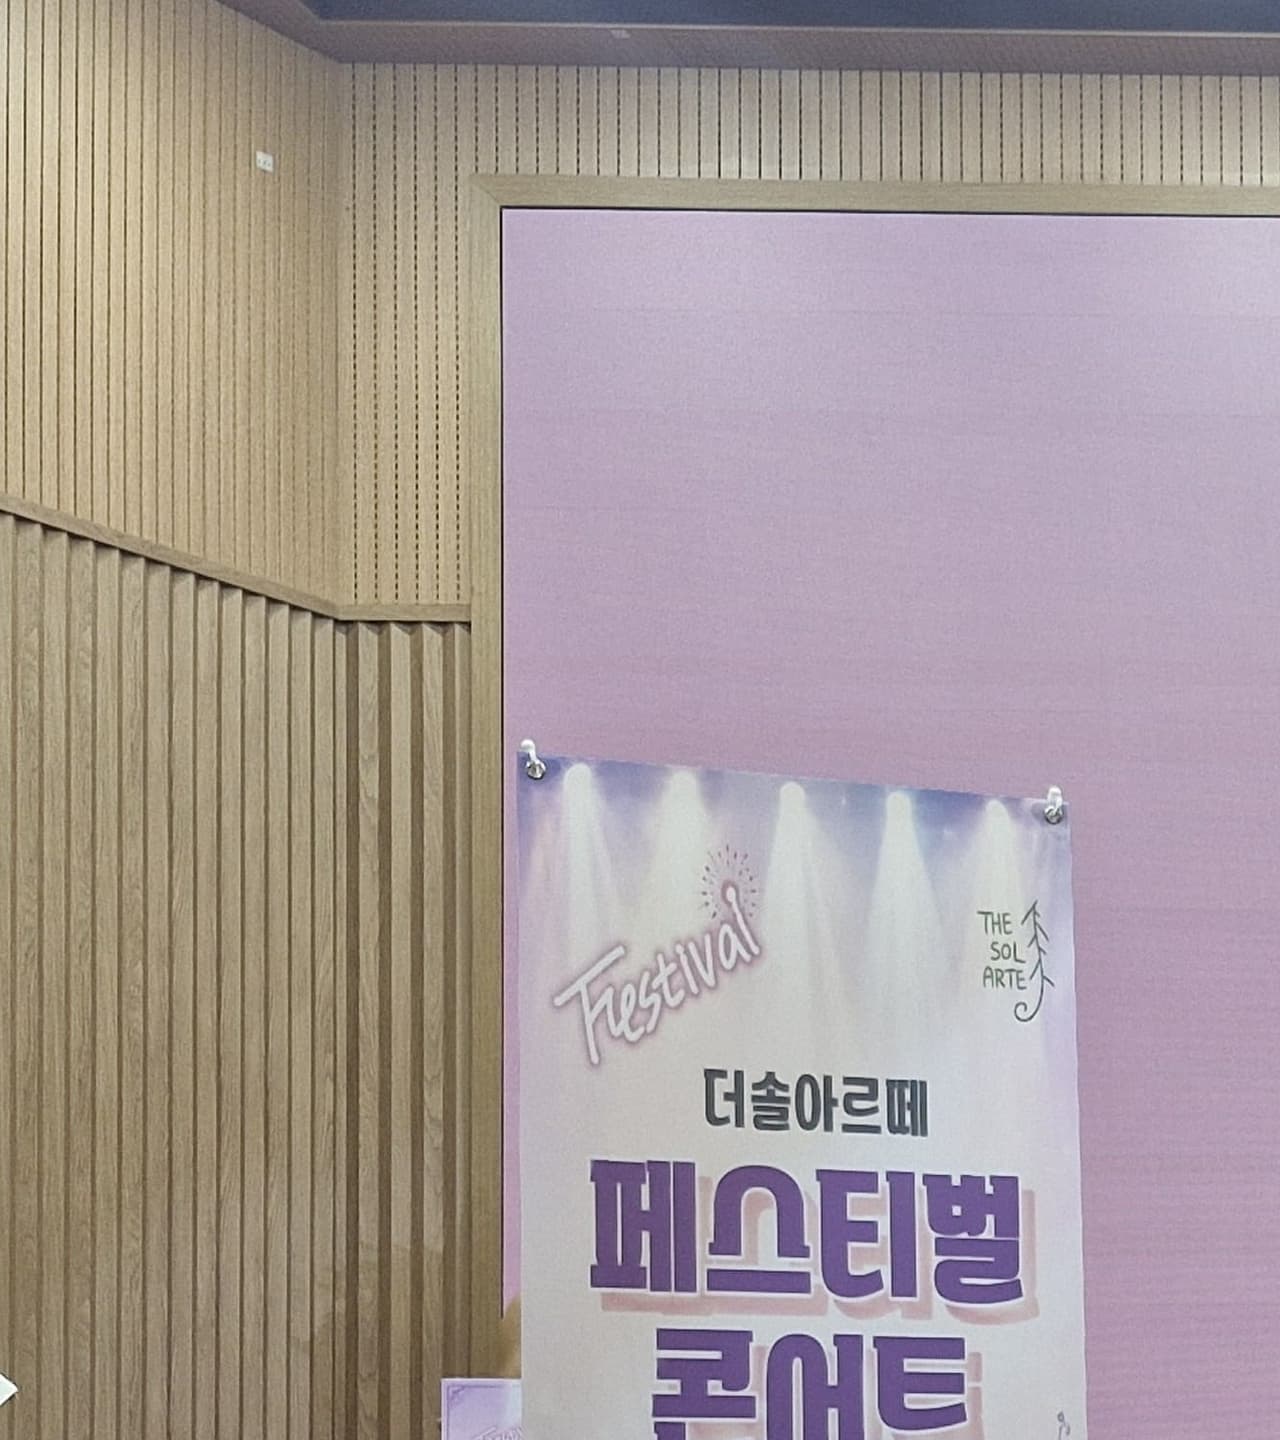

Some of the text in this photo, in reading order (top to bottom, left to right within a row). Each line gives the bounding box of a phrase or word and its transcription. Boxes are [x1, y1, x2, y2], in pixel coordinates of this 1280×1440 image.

[977, 910, 1013, 935] THE
[553, 886, 761, 1065] Festival
[990, 941, 1026, 964] SOL
[983, 965, 1027, 991] ARTE
[703, 1068, 929, 1137] 더솔아르떼
[590, 1159, 1024, 1304] 페스티벌
